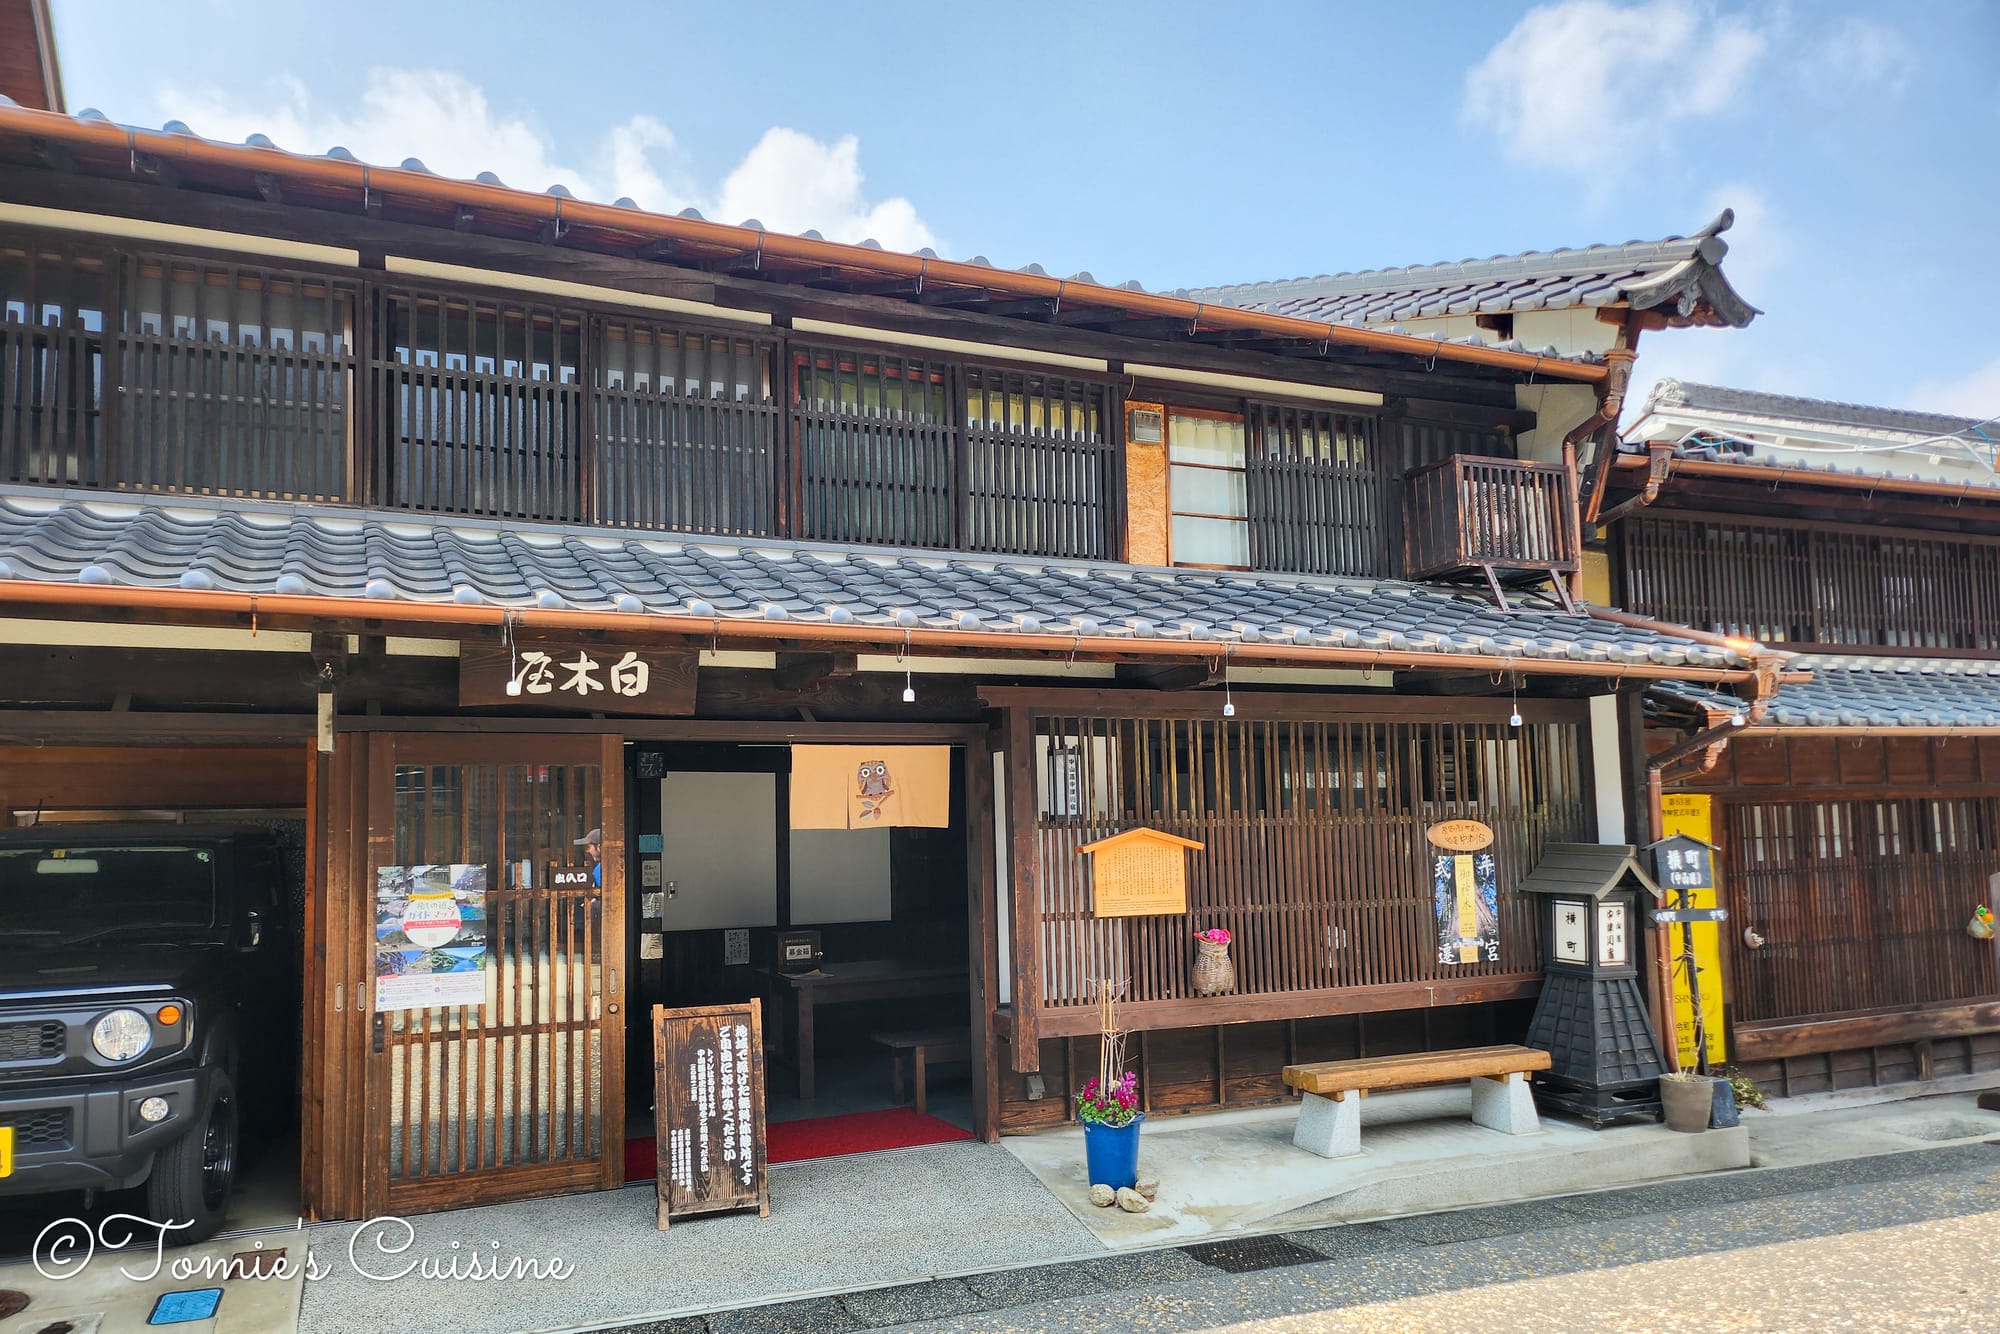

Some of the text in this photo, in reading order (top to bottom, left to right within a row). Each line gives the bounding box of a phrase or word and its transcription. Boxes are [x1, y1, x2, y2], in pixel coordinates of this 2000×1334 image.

[1667, 849, 1700, 870] 横町
[555, 872, 587, 884] 出入口
[1566, 912, 1577, 953] 横町
[1485, 939, 1500, 962] 宮
[706, 1048, 717, 1118] トイレはありません
[719, 1026, 736, 1161] ご自由にお休みください
